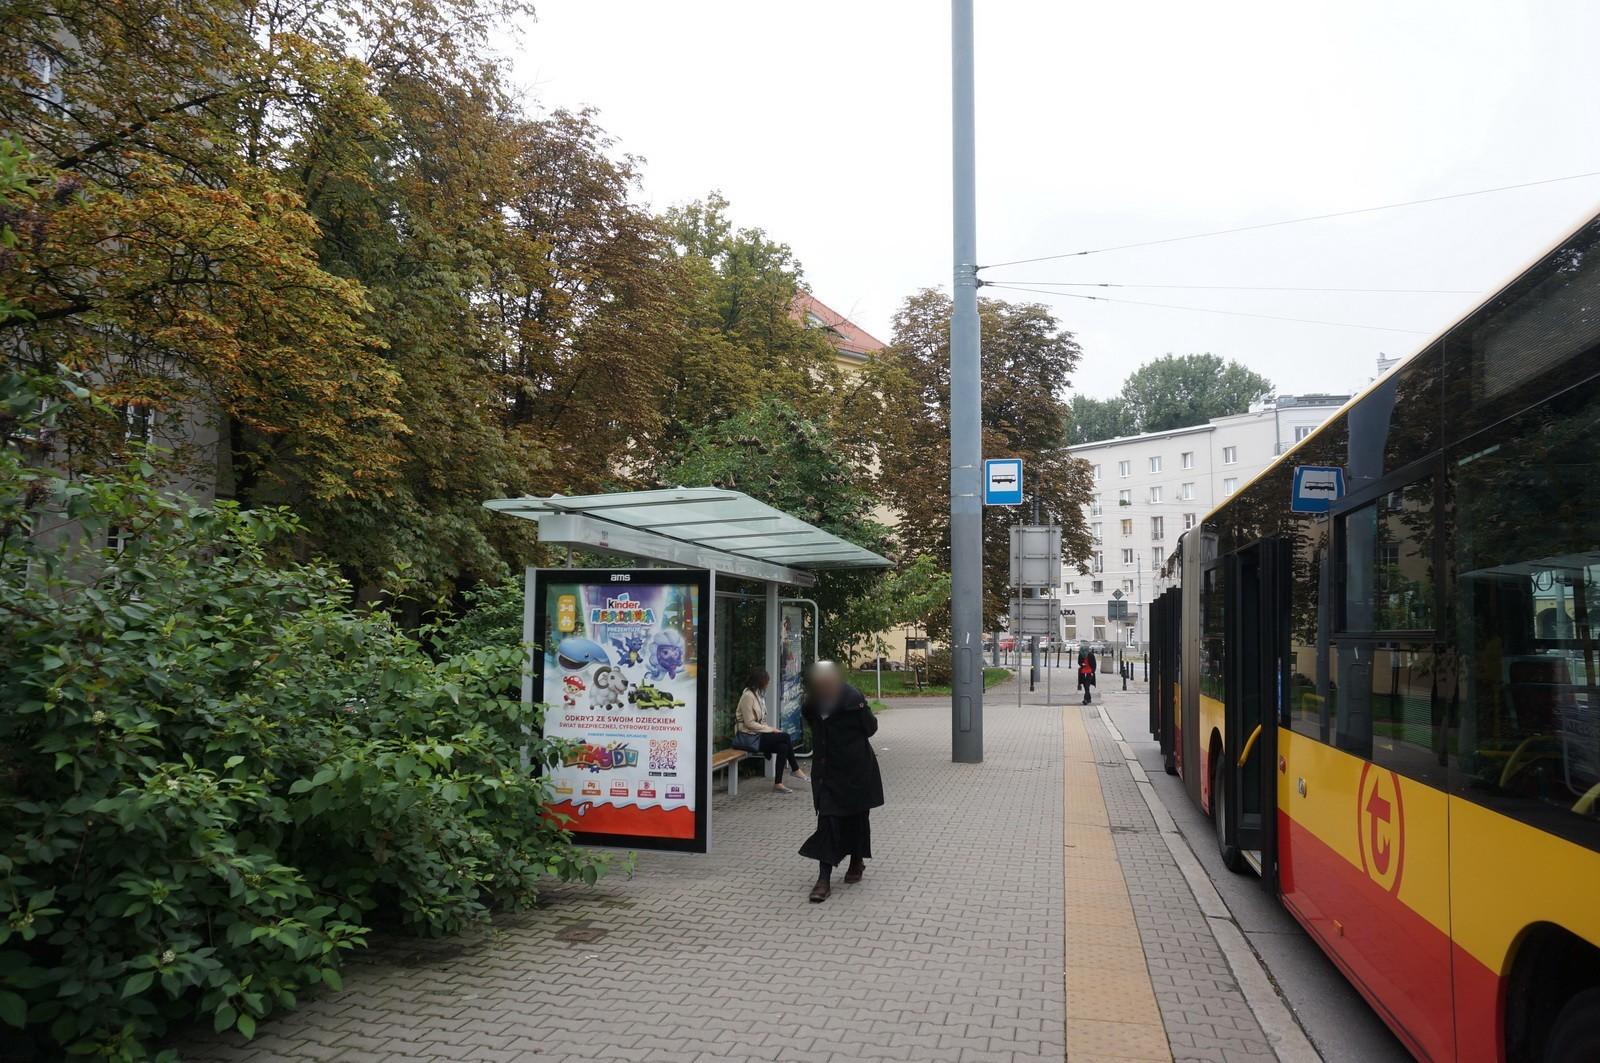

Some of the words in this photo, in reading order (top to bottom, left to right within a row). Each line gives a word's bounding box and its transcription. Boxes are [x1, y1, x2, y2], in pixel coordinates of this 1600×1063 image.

[610, 574, 631, 582] ams
[608, 598, 640, 609] Kinder
[635, 717, 676, 725] DZIECKIEM
